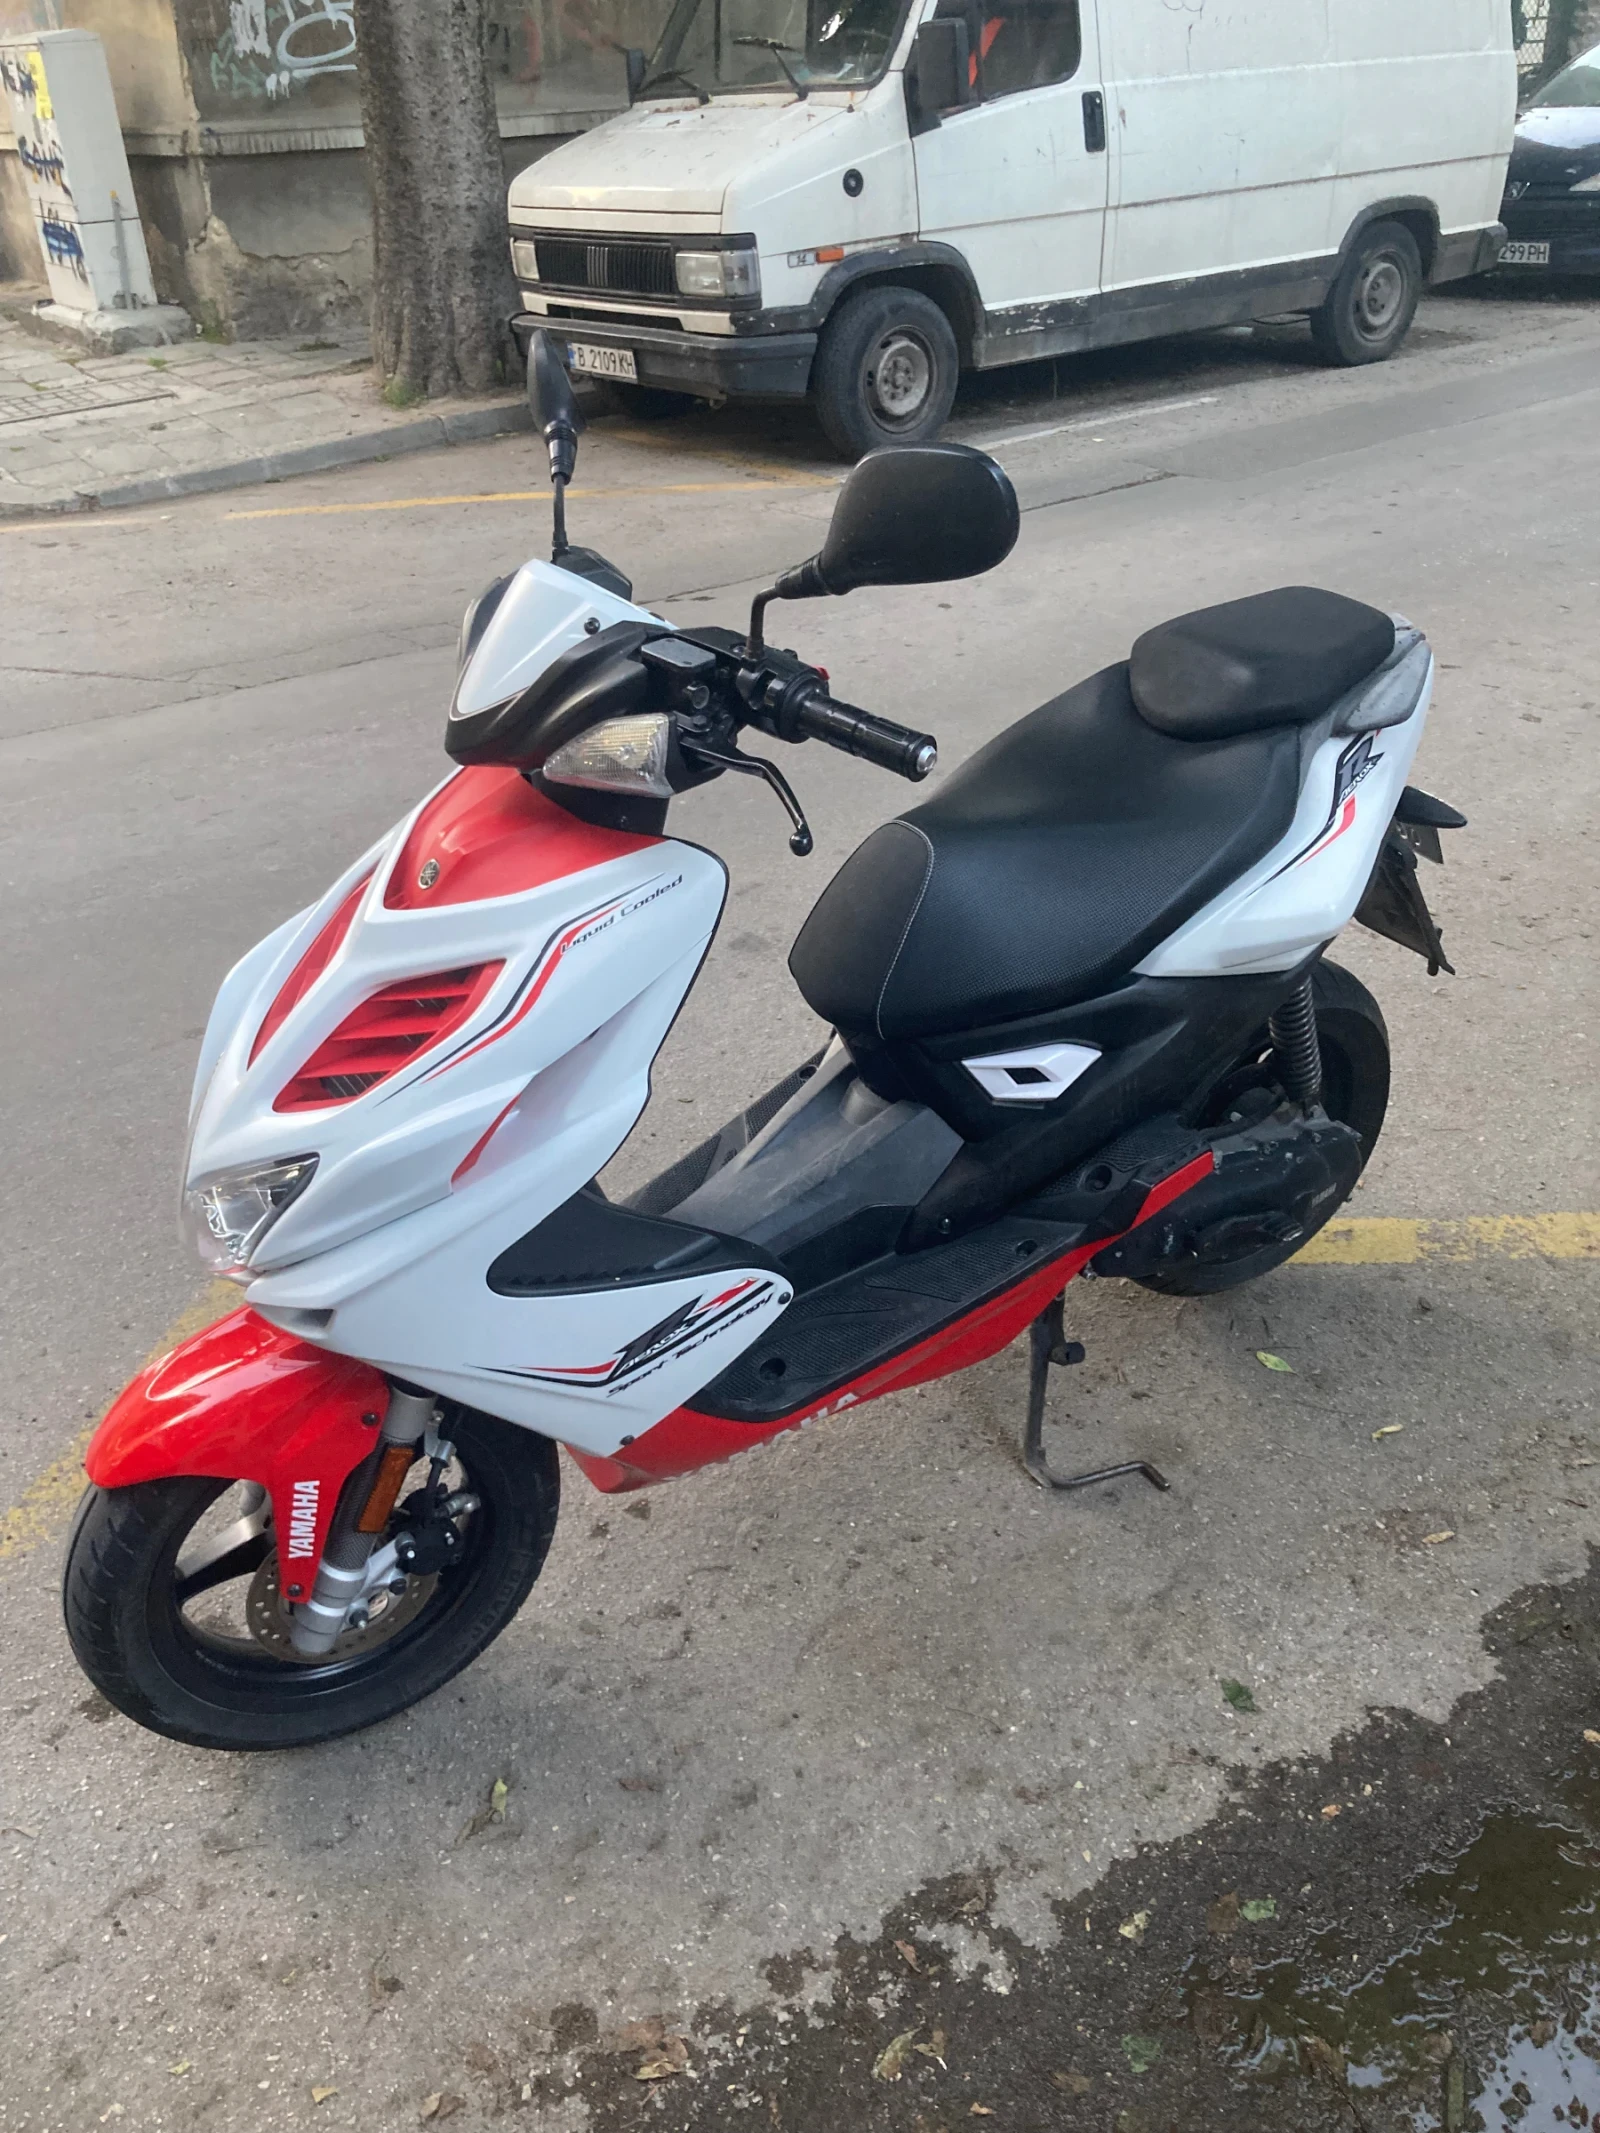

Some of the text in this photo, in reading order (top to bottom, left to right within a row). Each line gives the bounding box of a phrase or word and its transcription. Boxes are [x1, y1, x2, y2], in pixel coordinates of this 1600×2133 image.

[577, 346, 586, 367] B
[561, 874, 683, 954] Liquid Cooled
[606, 1292, 774, 1398] Sport Technology
[288, 1480, 320, 1559] YAMAHA
